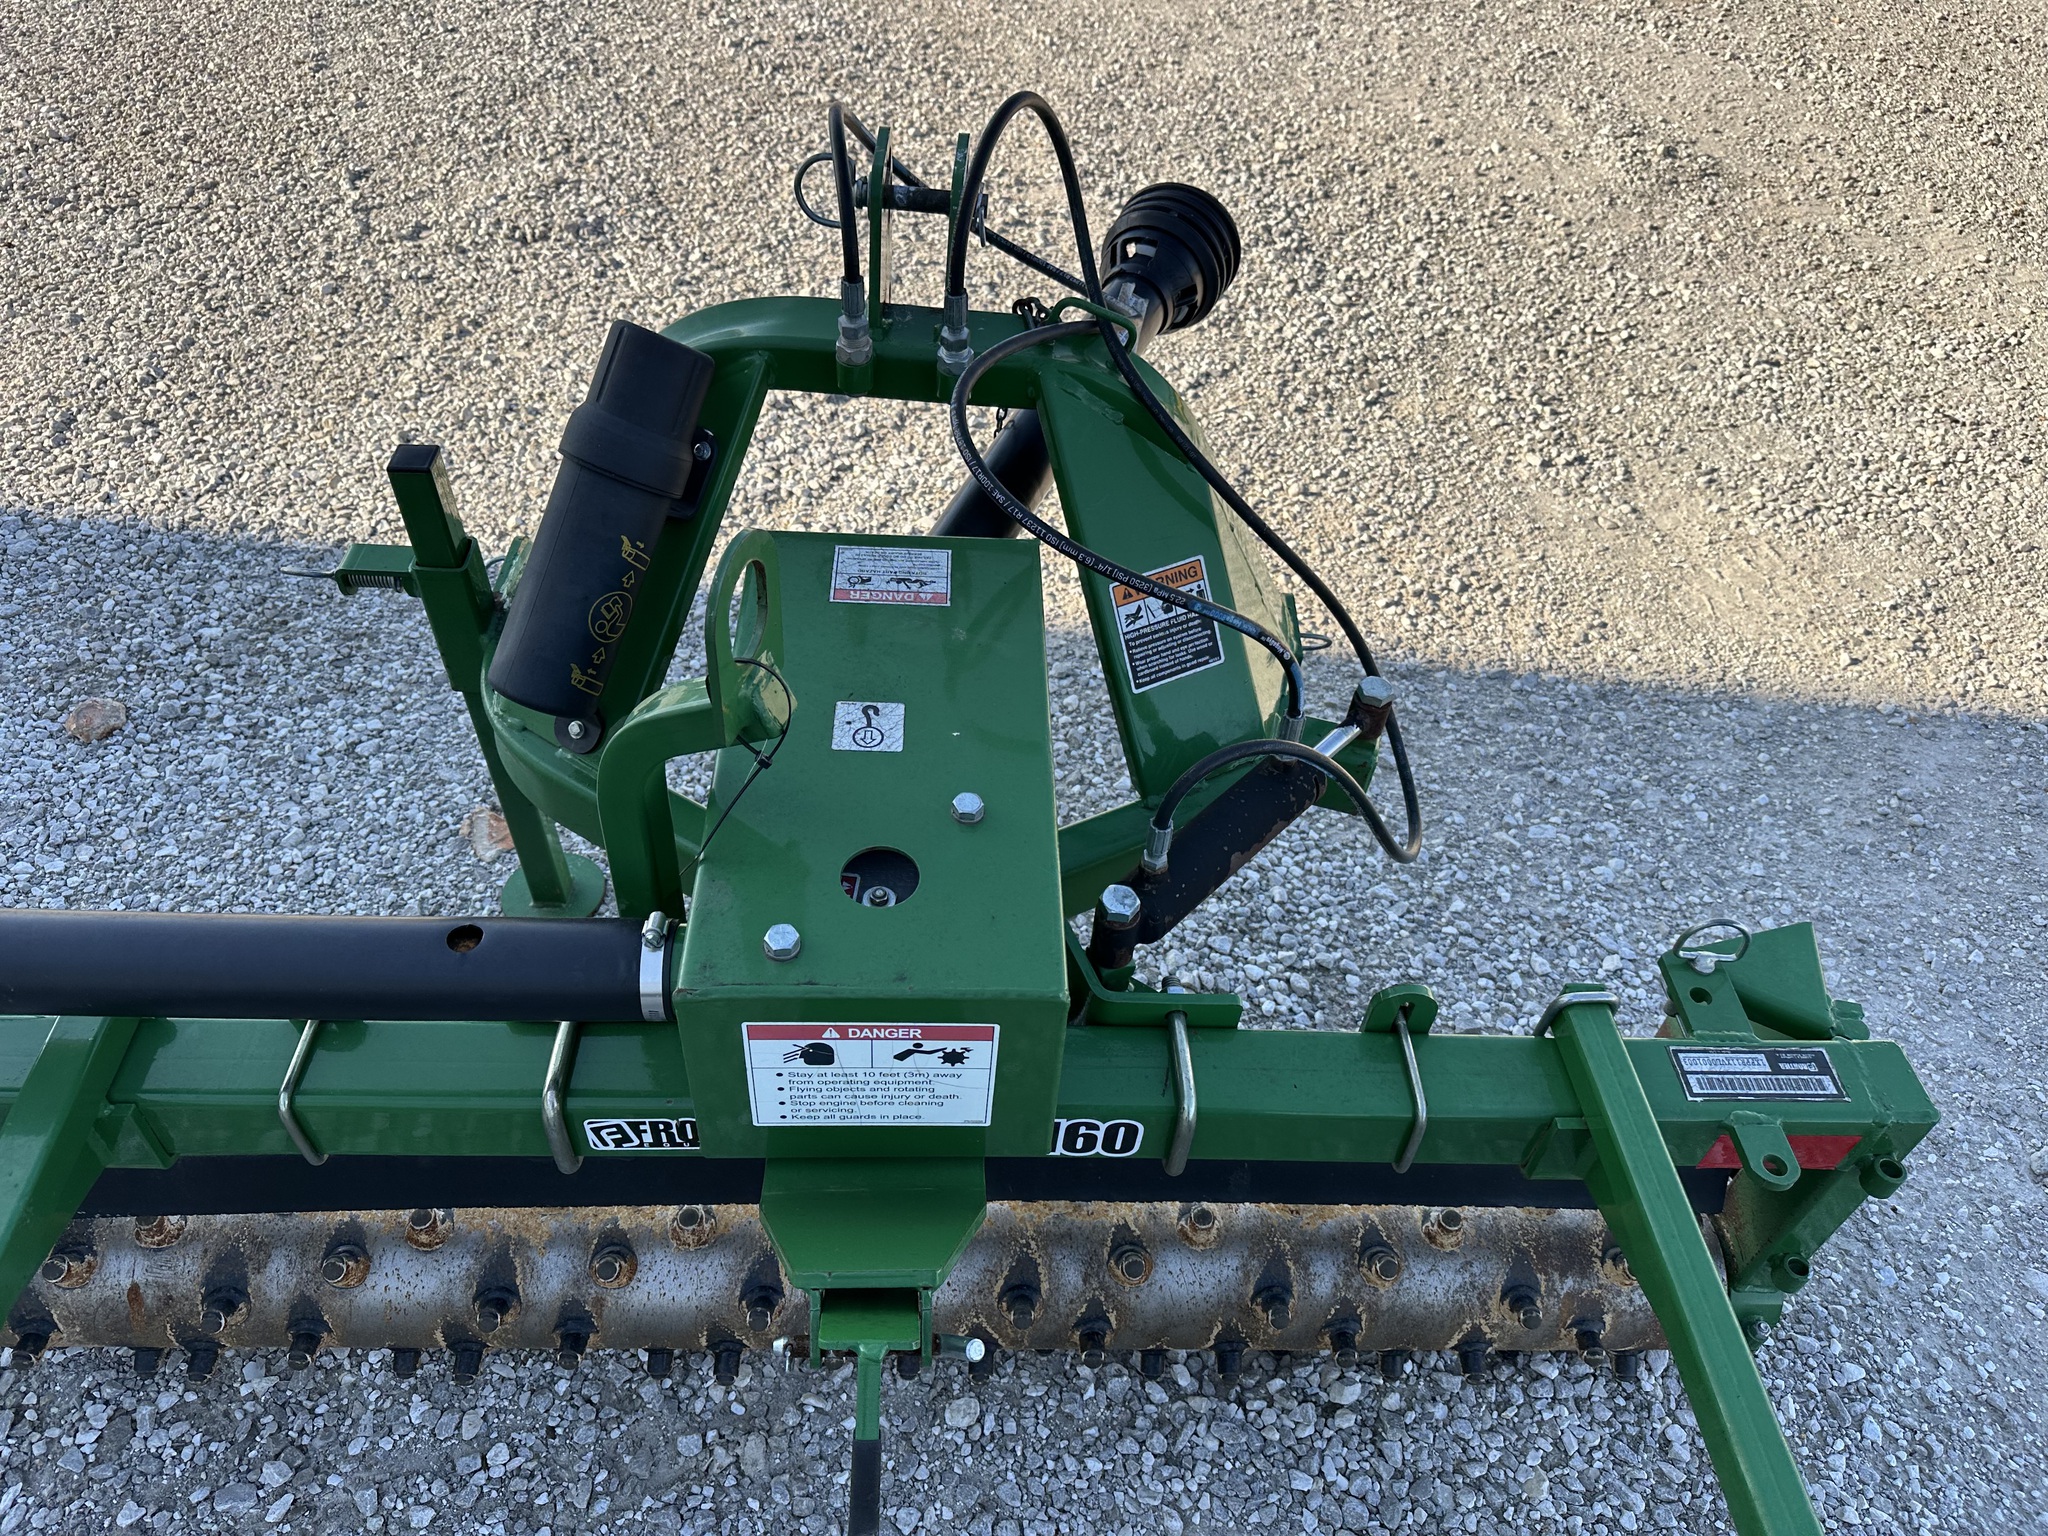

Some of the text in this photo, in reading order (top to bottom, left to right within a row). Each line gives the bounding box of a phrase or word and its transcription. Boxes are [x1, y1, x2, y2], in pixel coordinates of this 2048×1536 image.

[960, 447, 973, 462] ISO
[990, 487, 1006, 504] SAE
[1007, 503, 1024, 520] R17
[1020, 515, 1047, 537] 11237
[1044, 532, 1060, 546] ISO
[849, 590, 914, 600] DANGER
[1152, 586, 1169, 598] MPa
[1168, 592, 1186, 606] 22.5
[1169, 614, 1187, 624] FLUID
[848, 1028, 922, 1038] DANGER
